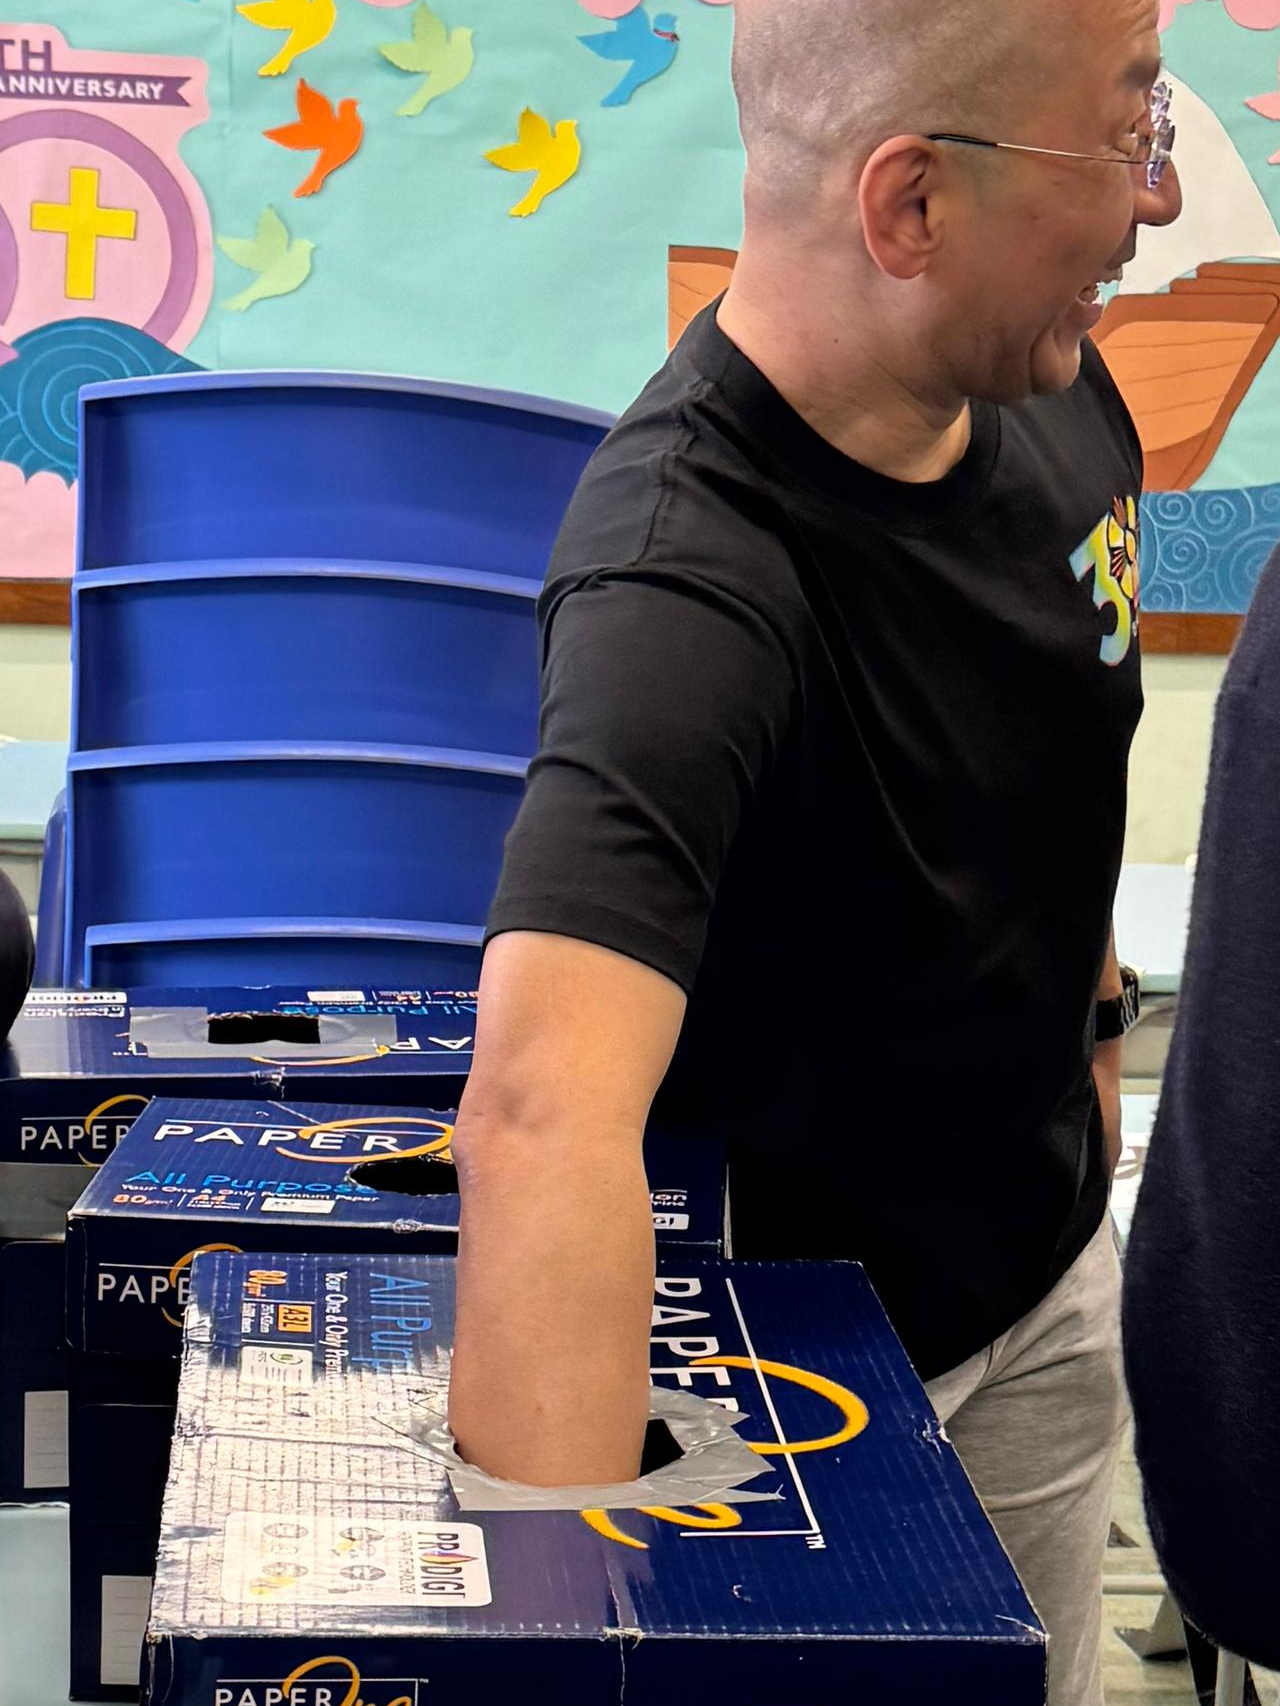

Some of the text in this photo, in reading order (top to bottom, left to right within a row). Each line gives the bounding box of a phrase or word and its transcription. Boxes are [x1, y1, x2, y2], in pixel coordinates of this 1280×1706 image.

[153, 1124, 403, 1152] PAPER
[125, 1171, 186, 1185] All
[369, 1272, 431, 1306] All
[325, 1293, 349, 1313] One
[318, 1324, 349, 1347] Only
[650, 1277, 740, 1413] PAPE
